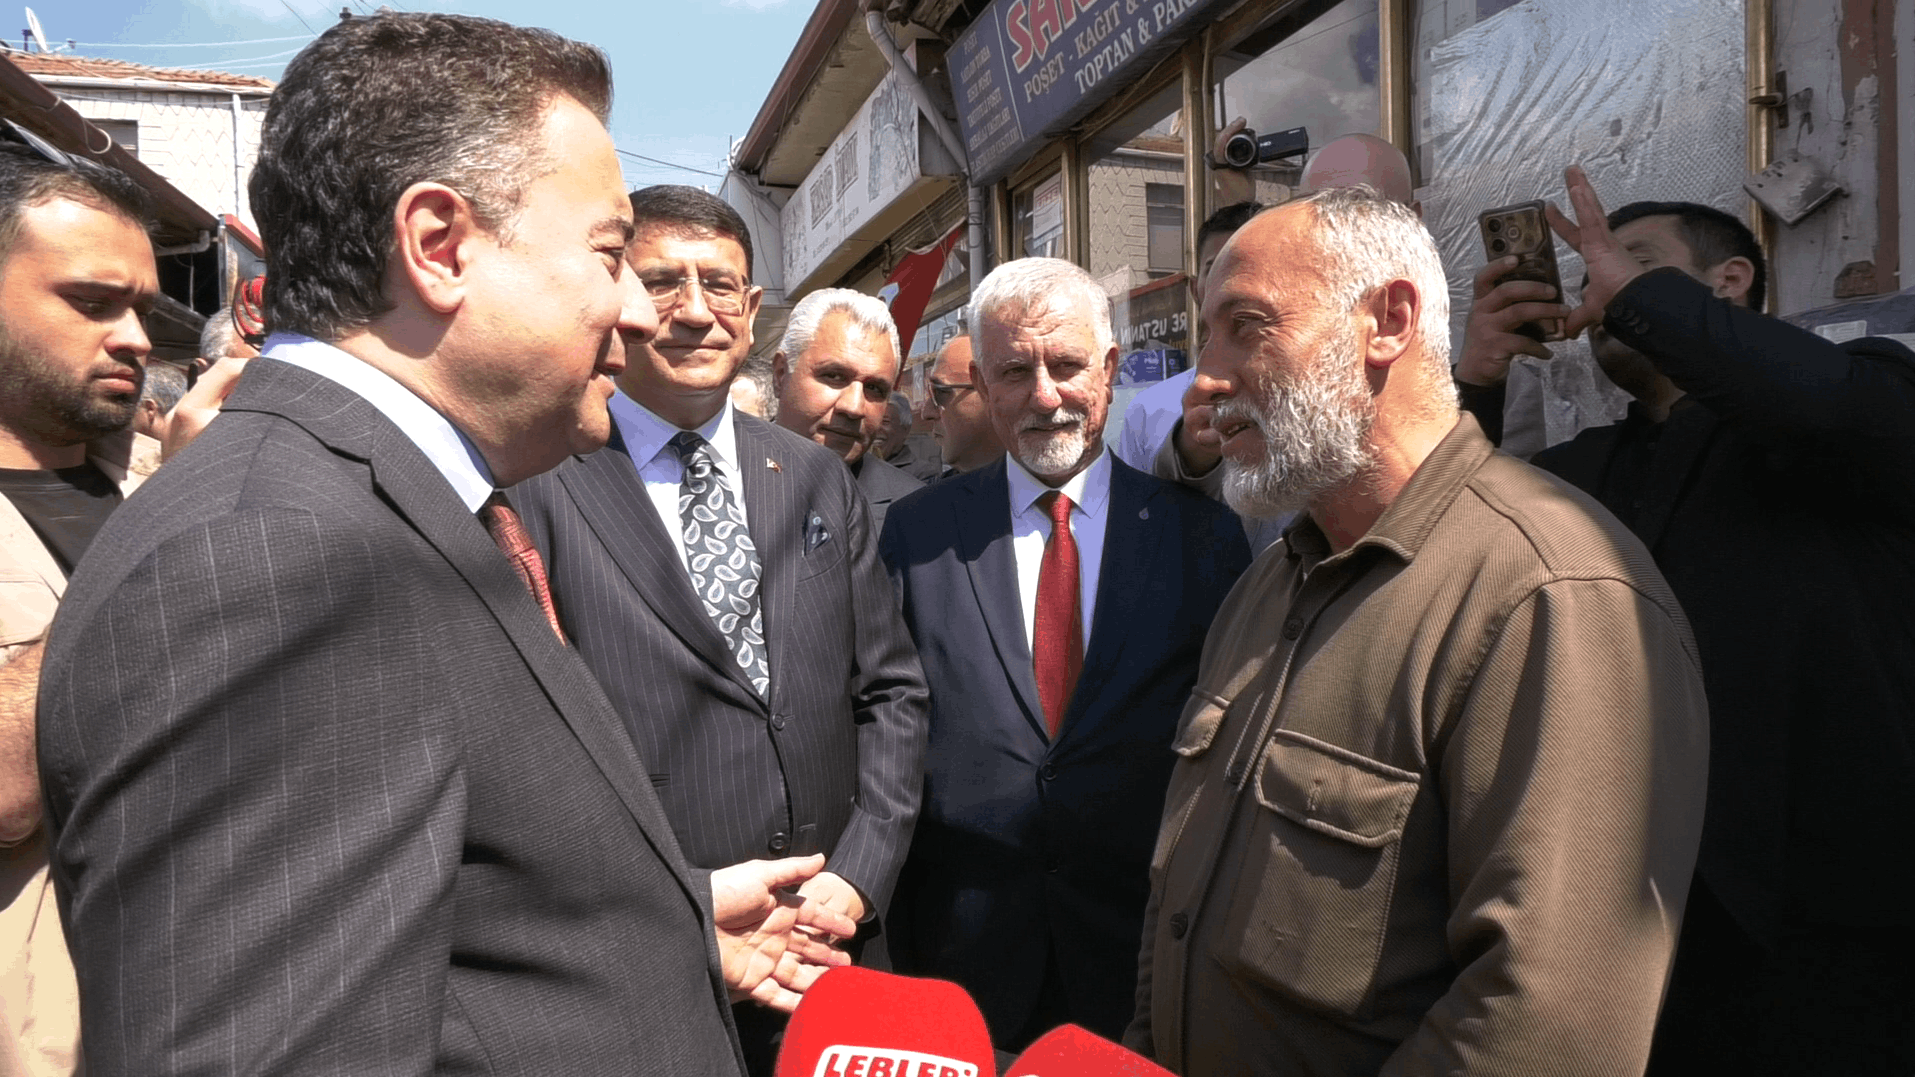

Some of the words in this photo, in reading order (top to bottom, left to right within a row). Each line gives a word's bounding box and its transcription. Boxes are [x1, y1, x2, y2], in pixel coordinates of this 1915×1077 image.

[1024, 51, 1065, 103] POŞET
[1074, 0, 1120, 59] KAĞIT
[1075, 27, 1135, 94] TOPTAN
[1138, 17, 1152, 45] &
